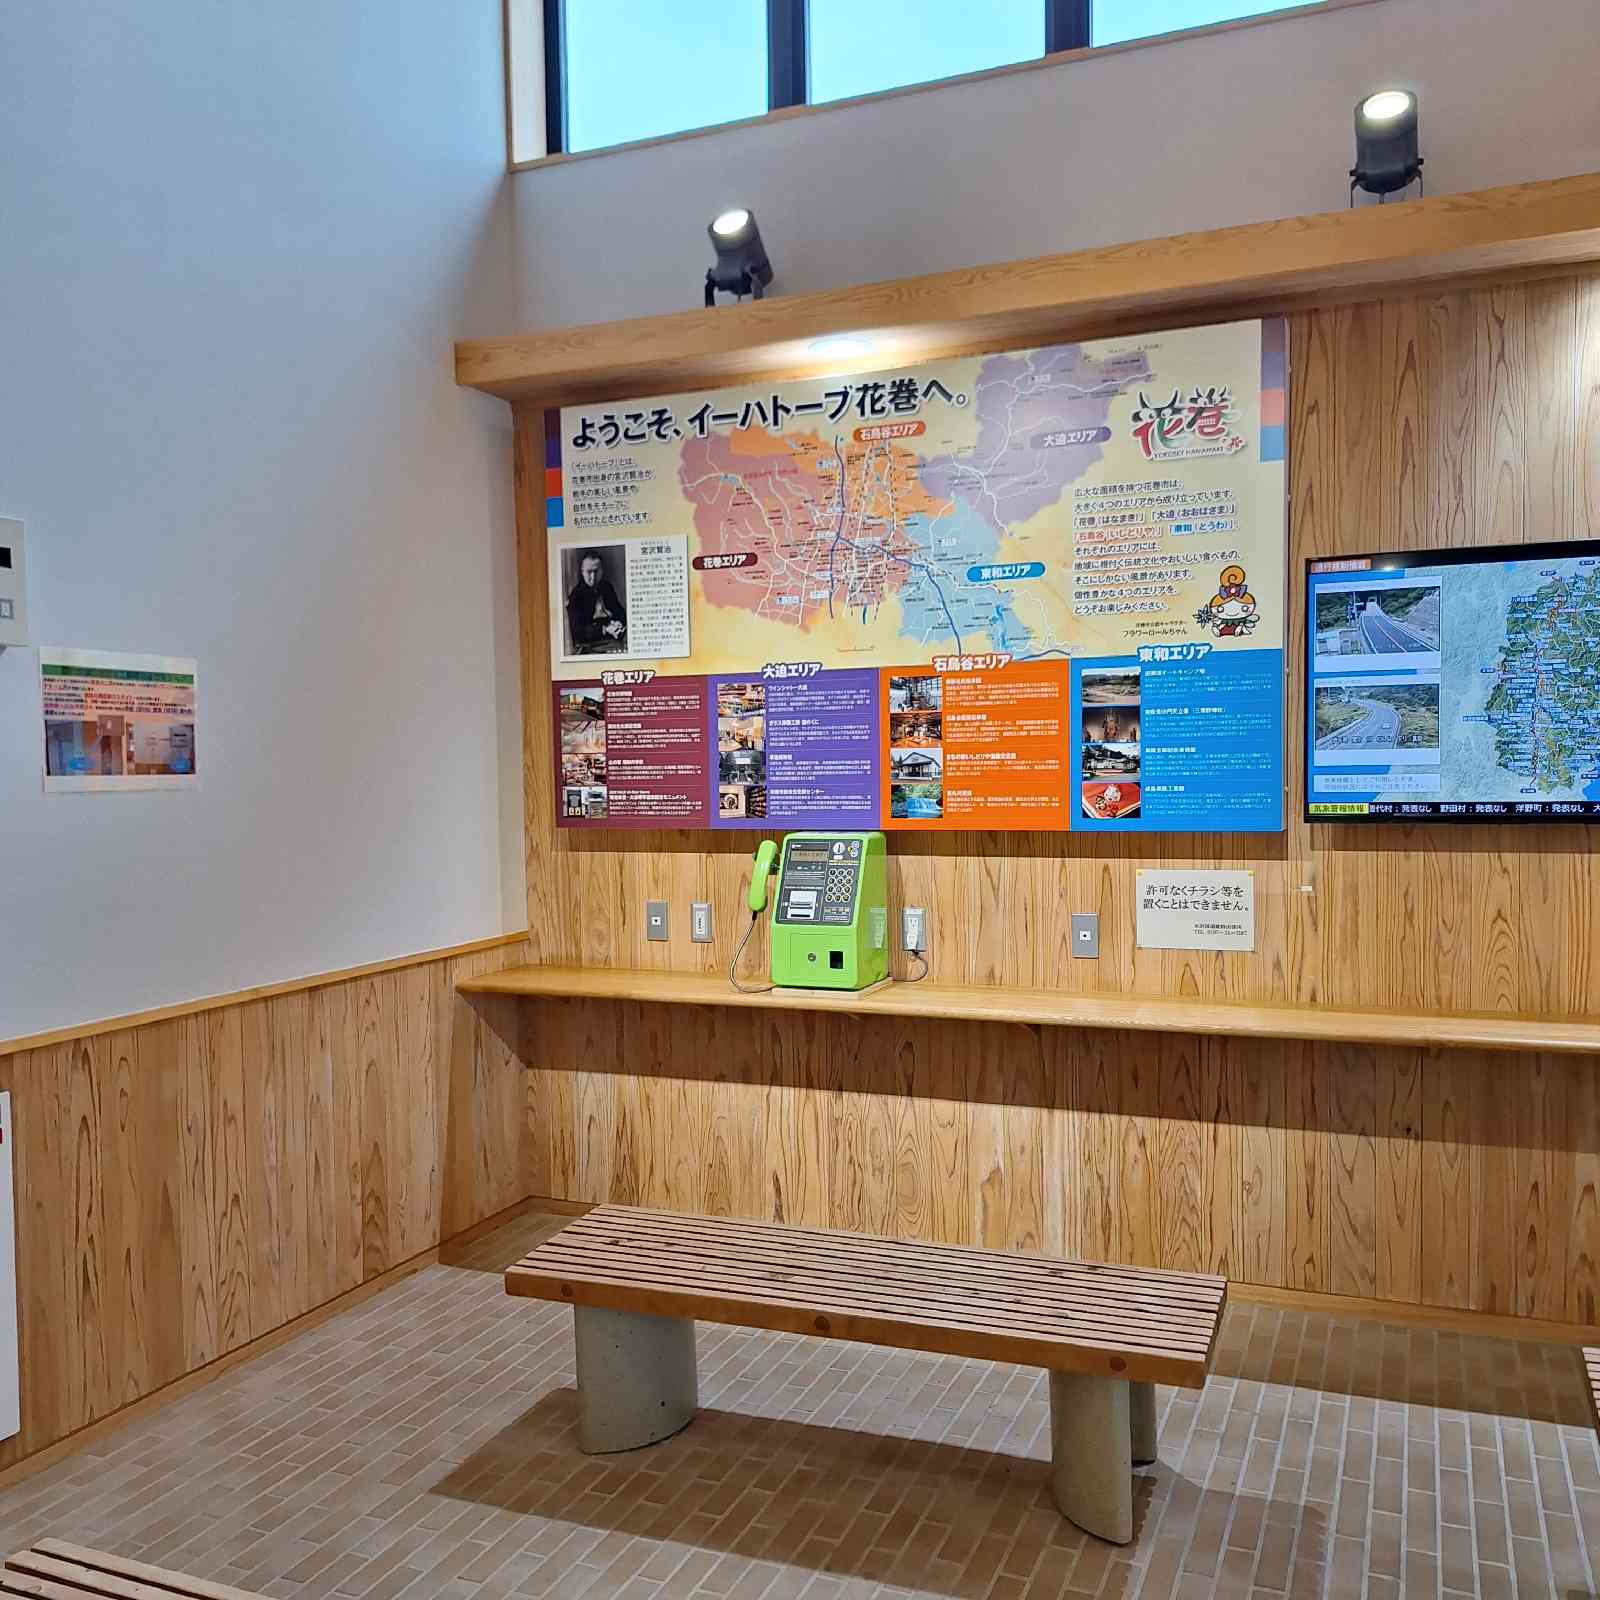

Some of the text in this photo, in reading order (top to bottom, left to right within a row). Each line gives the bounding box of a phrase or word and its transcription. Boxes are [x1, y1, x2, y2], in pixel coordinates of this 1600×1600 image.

[571, 377, 968, 449] ようこそ、イーハトーブ花巻へ。
[1044, 429, 1097, 446] 大迫エリア
[703, 554, 747, 569] 花巻エリア
[981, 564, 1031, 580] 東和エリア
[1139, 645, 1211, 662] 東和エリア
[934, 654, 1011, 671] 石鳥谷エリア
[602, 671, 654, 686] 花巻エリア
[763, 663, 821, 679] 大迫エリア
[1147, 885, 1244, 897] 許可なくチラシ等を
[1144, 899, 1249, 912] 置くことはできません。
